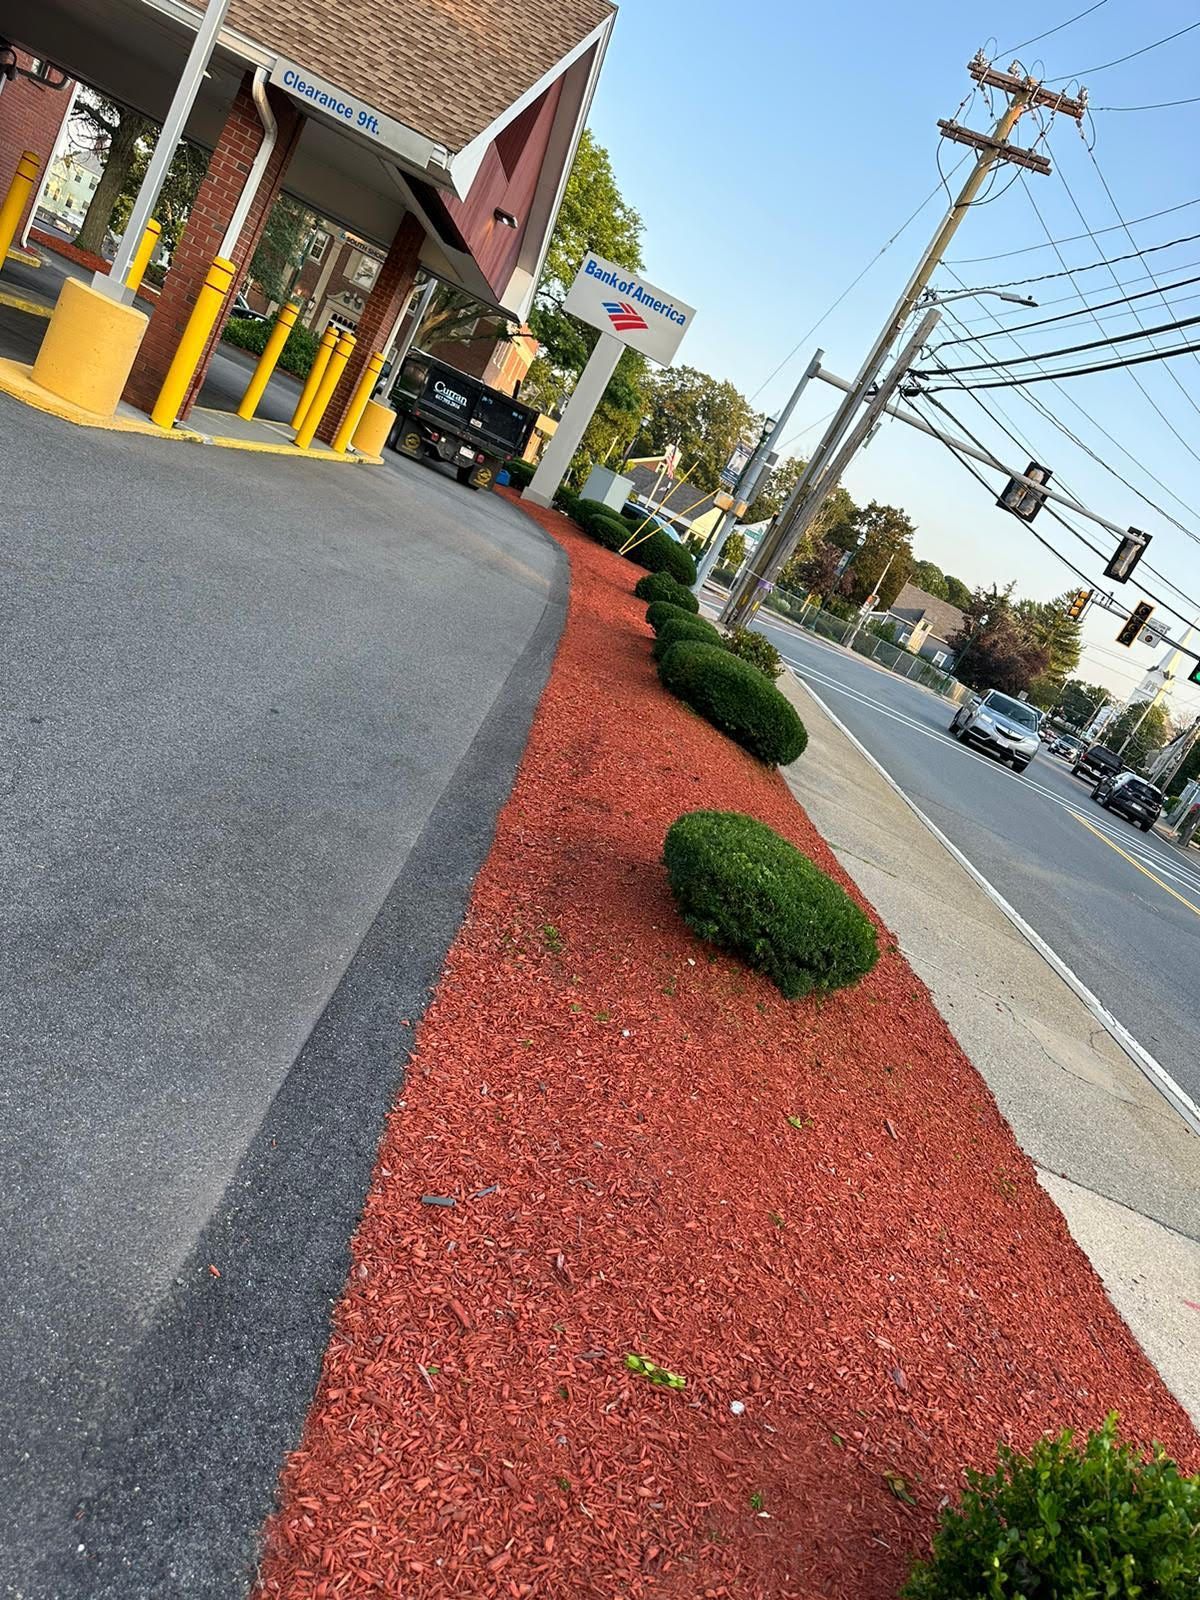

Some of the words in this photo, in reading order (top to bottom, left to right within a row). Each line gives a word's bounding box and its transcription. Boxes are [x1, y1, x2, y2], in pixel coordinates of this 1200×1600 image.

[283, 70, 354, 119] Clearance
[357, 111, 380, 135] 9ft.
[584, 259, 620, 288] Bank
[618, 281, 636, 295] of
[631, 286, 687, 326] America
[434, 381, 468, 407] Curran
